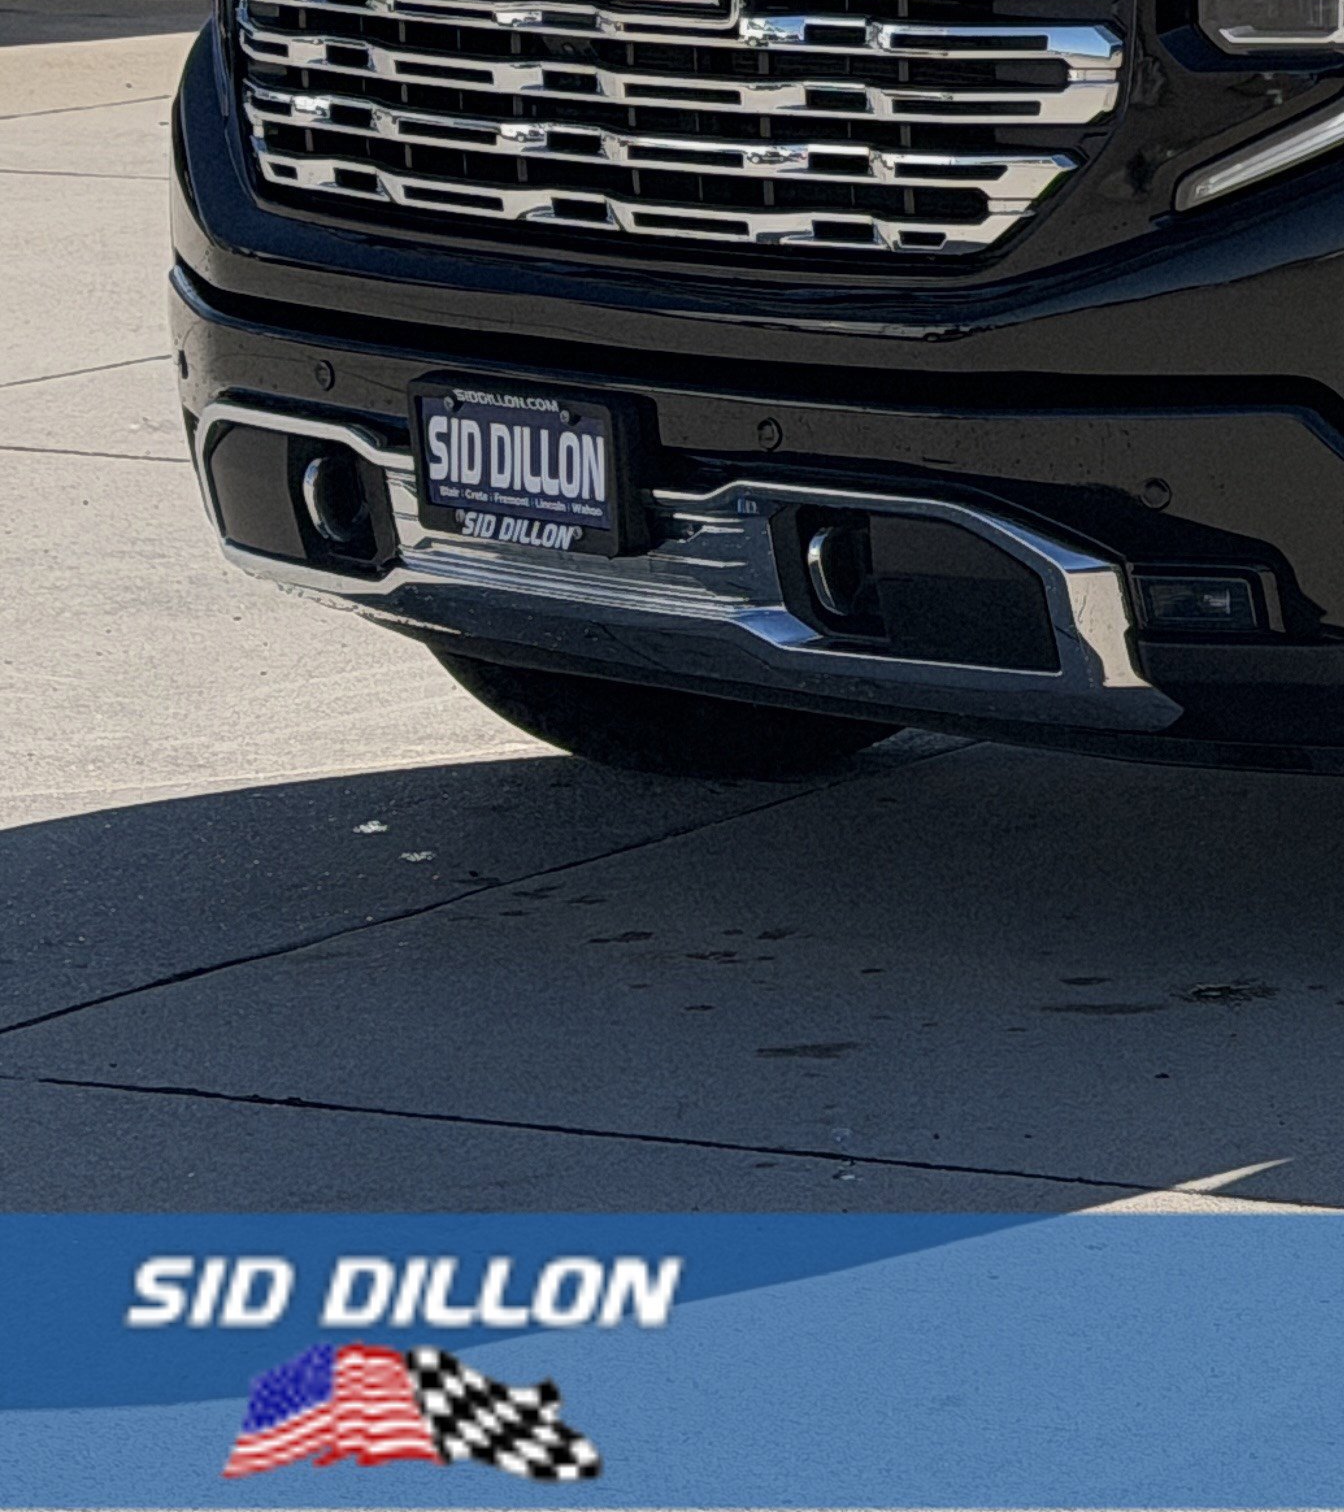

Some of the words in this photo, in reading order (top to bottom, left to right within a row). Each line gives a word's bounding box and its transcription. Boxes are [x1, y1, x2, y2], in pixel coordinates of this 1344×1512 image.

[452, 388, 559, 413] SIDDILLON.COM
[428, 415, 483, 485] SID
[489, 422, 605, 502] DILLON
[494, 492, 529, 507] Fremont
[535, 498, 567, 512] Lincoln
[572, 502, 604, 517] Wahoo
[461, 511, 496, 539] SID
[498, 516, 574, 550] DILLON
